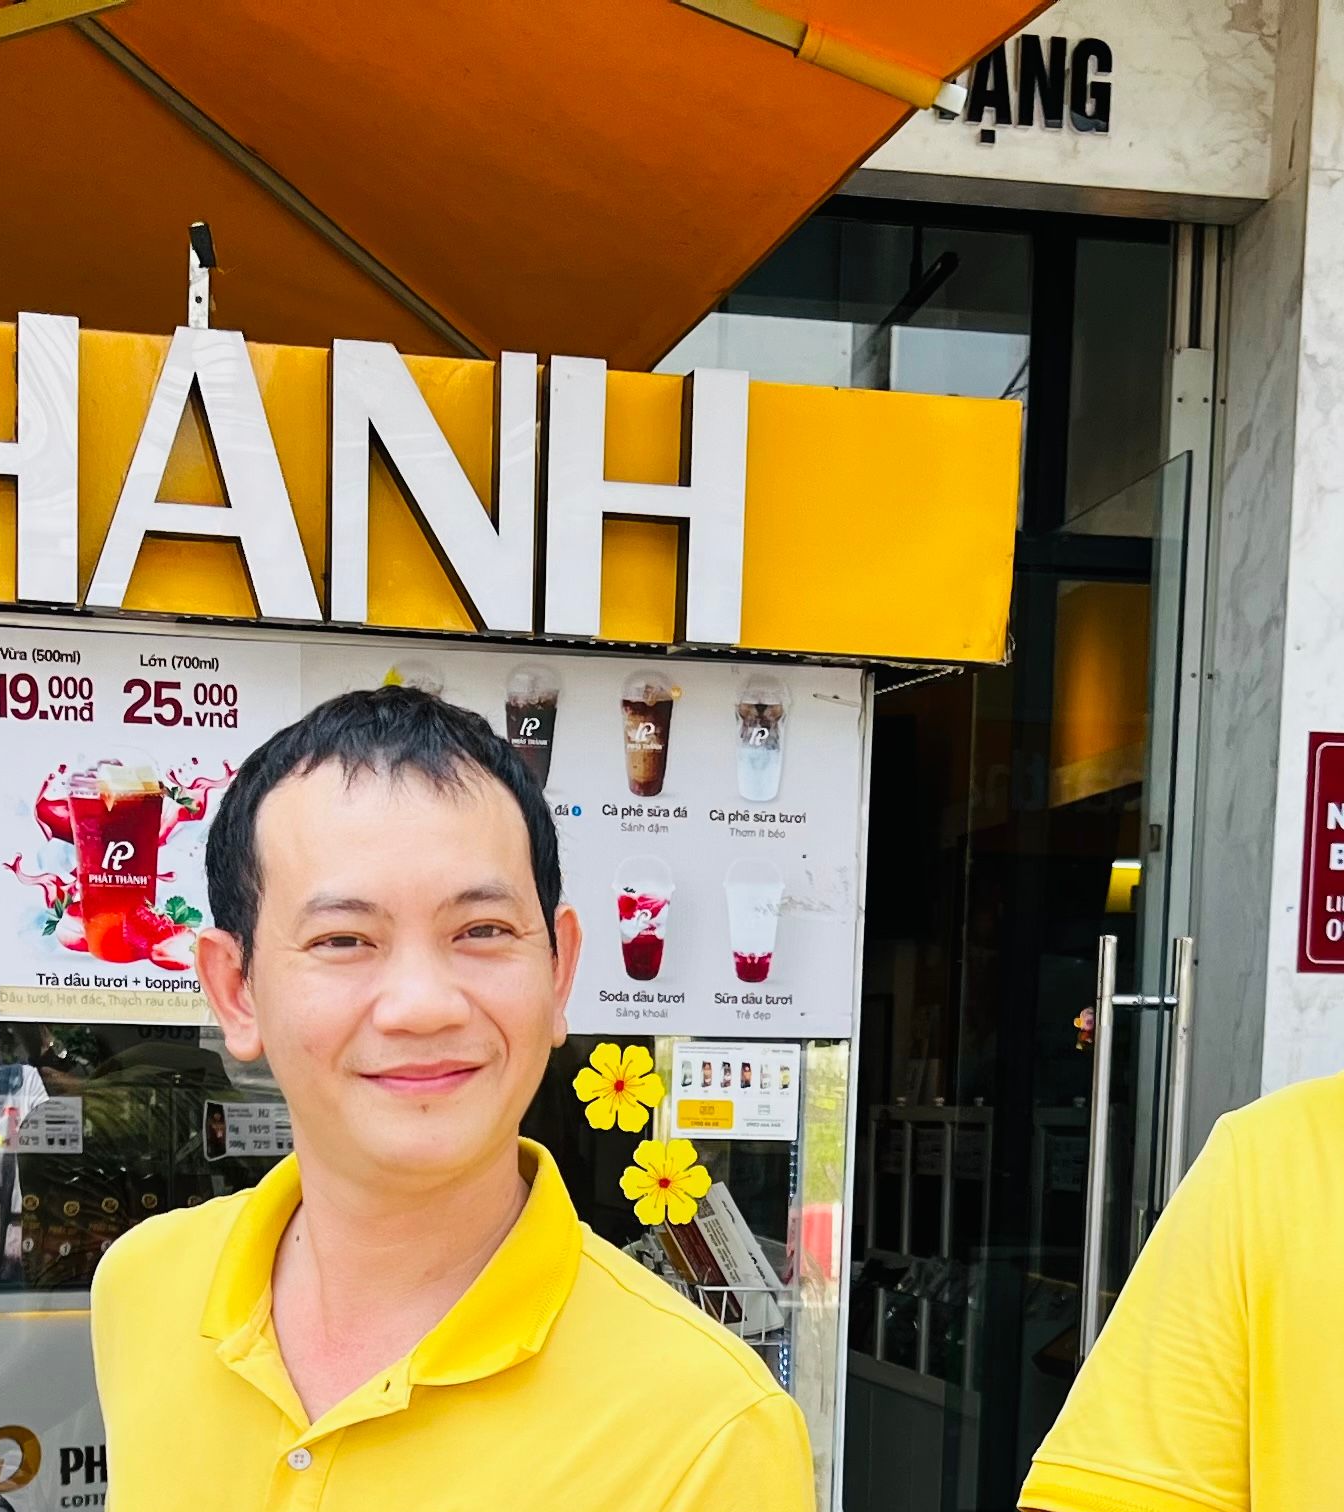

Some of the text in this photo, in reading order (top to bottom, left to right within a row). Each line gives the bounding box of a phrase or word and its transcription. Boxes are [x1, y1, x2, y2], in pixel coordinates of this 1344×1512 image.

[936, 34, 1113, 144] ẠNG
[192, 683, 238, 707] 000
[194, 706, 239, 730] vnđ
[602, 804, 618, 818] Cà
[622, 803, 644, 821] phê
[673, 805, 688, 819] đá
[709, 809, 725, 823] Cà
[728, 809, 751, 826] phê
[36, 972, 201, 993] Trà dâu tươi topping
[599, 990, 629, 1003] Soda
[632, 990, 654, 1004] dâu
[741, 992, 763, 1005] dâu
